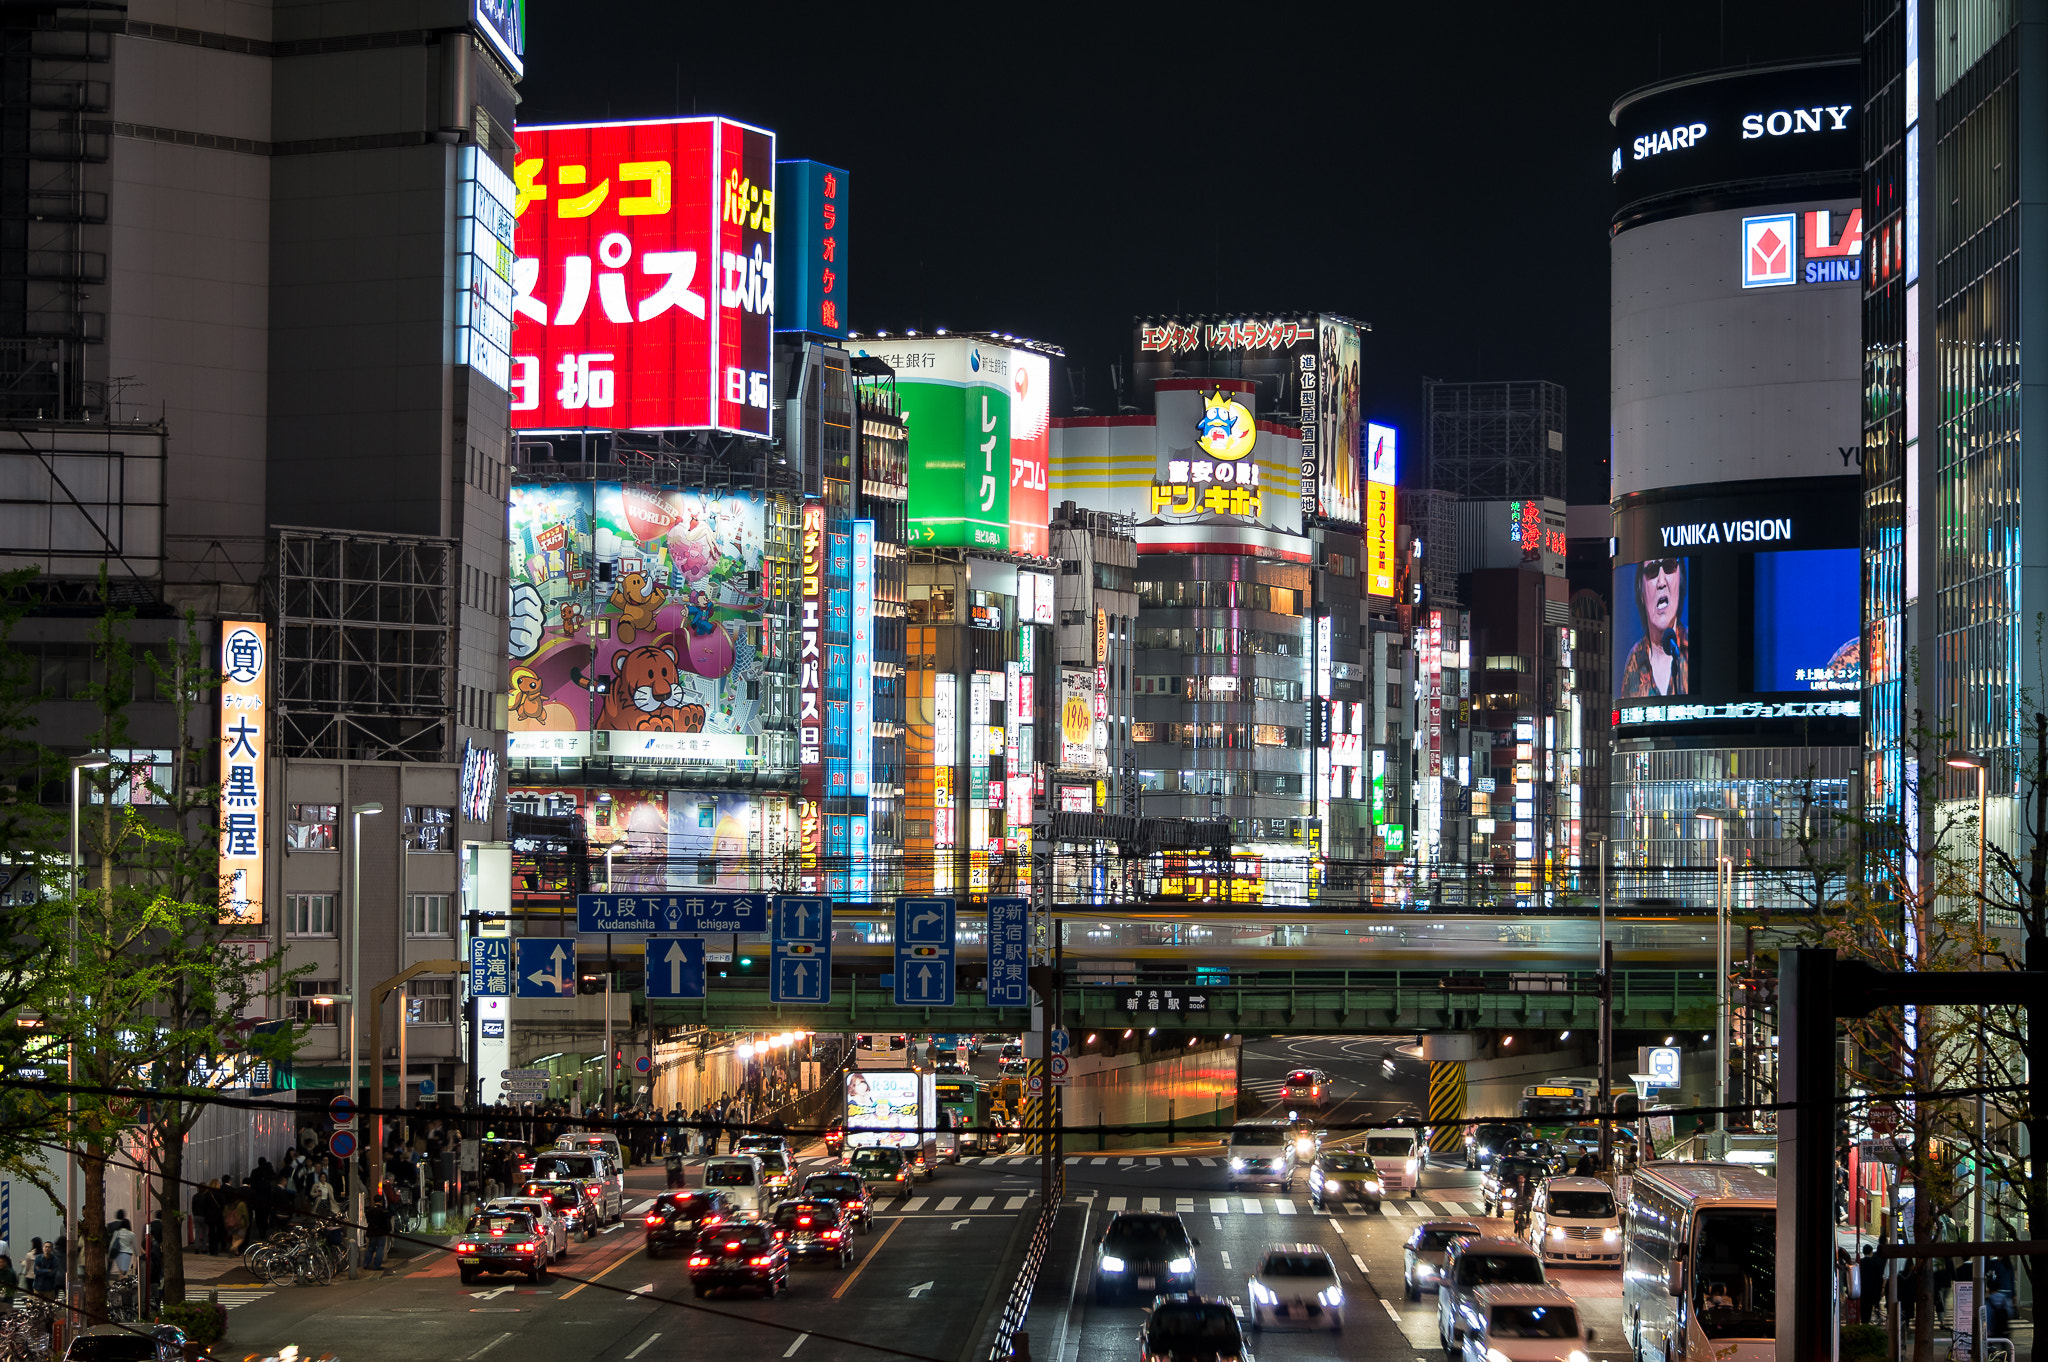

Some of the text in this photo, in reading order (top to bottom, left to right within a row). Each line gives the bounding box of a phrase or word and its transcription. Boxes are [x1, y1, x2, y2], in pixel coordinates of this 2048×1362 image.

[1633, 104, 1852, 161] SHARP SONY
[722, 167, 773, 232] パチンコ
[820, 172, 840, 330] カラオケ館
[722, 242, 774, 315] エスパス
[1141, 324, 1200, 353] エンタメ
[1204, 321, 1315, 353] レストランタワー
[982, 355, 1008, 376] 新生銀行
[726, 365, 769, 410] 日拓
[1300, 353, 1317, 513] 進化型居酒屋の聖地
[979, 394, 998, 512] レイク
[1011, 457, 1047, 491] アコム
[622, 487, 679, 520] JUGGLER
[628, 504, 671, 527] WORLD
[1023, 533, 1035, 550] 3F
[1378, 489, 1387, 571] PROMISE
[1660, 518, 1791, 547] YUNIKA VISION
[231, 637, 258, 677] 質
[225, 695, 263, 709] チケット
[539, 737, 579, 750] 北電子
[677, 738, 711, 751] 北電子
[226, 715, 259, 858] 大黒屋
[592, 898, 662, 918] 九段下
[597, 919, 656, 930] Kudanshita
[669, 909, 677, 920] 4
[697, 919, 741, 931] Ichigaya
[992, 906, 1005, 955] Shinjuku
[473, 940, 485, 993] Otaki Brdg.
[486, 940, 507, 994] 小滝橋
[1005, 903, 1023, 1000] 新宿駅東口
[1127, 998, 1180, 1010] 新宿駅
